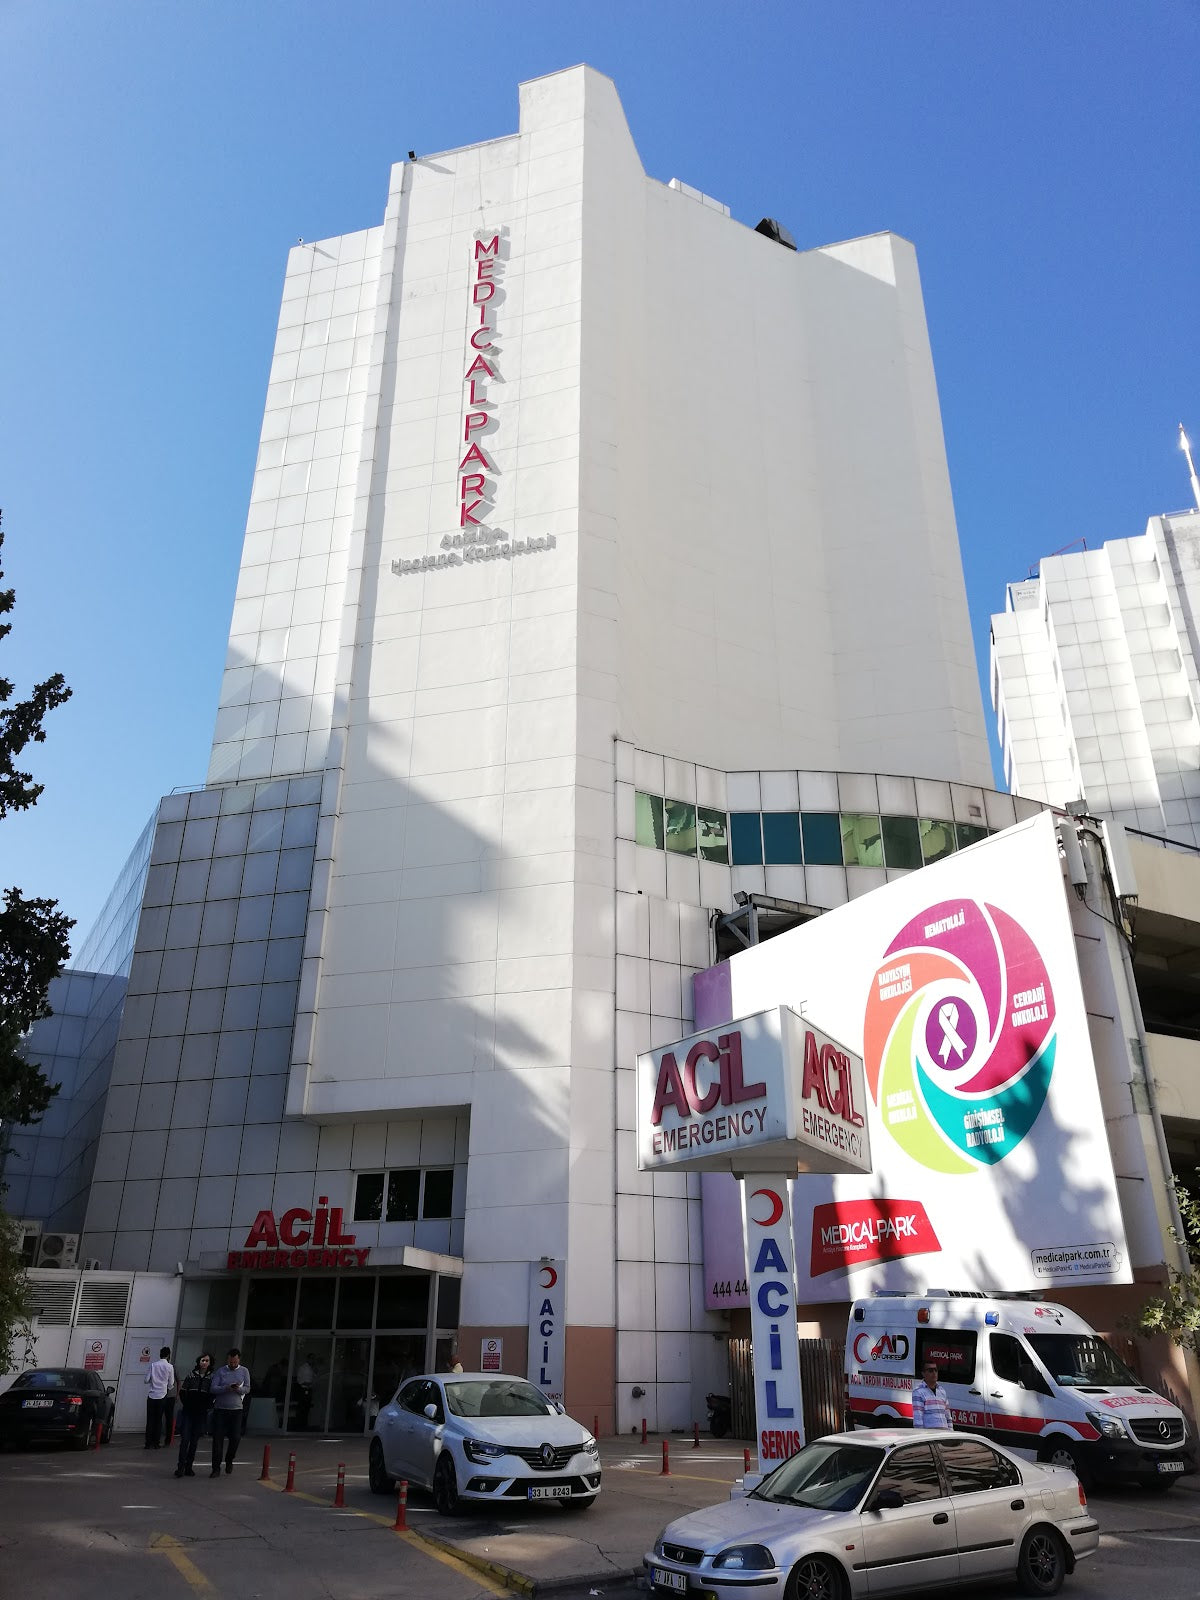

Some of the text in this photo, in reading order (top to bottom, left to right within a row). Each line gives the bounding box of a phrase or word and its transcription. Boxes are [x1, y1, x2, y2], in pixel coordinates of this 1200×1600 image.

[652, 1106, 767, 1156] EMERGENCY
[802, 1107, 863, 1158] EMERGENCY
[226, 1248, 371, 1270] EMERGENCY
[1036, 1248, 1110, 1264] medicalpark.com.tr
[712, 1281, 732, 1298] 444
[958, 1411, 968, 1424] 46
[969, 1412, 978, 1425] 47
[532, 1487, 570, 1498] 33 L 8243
